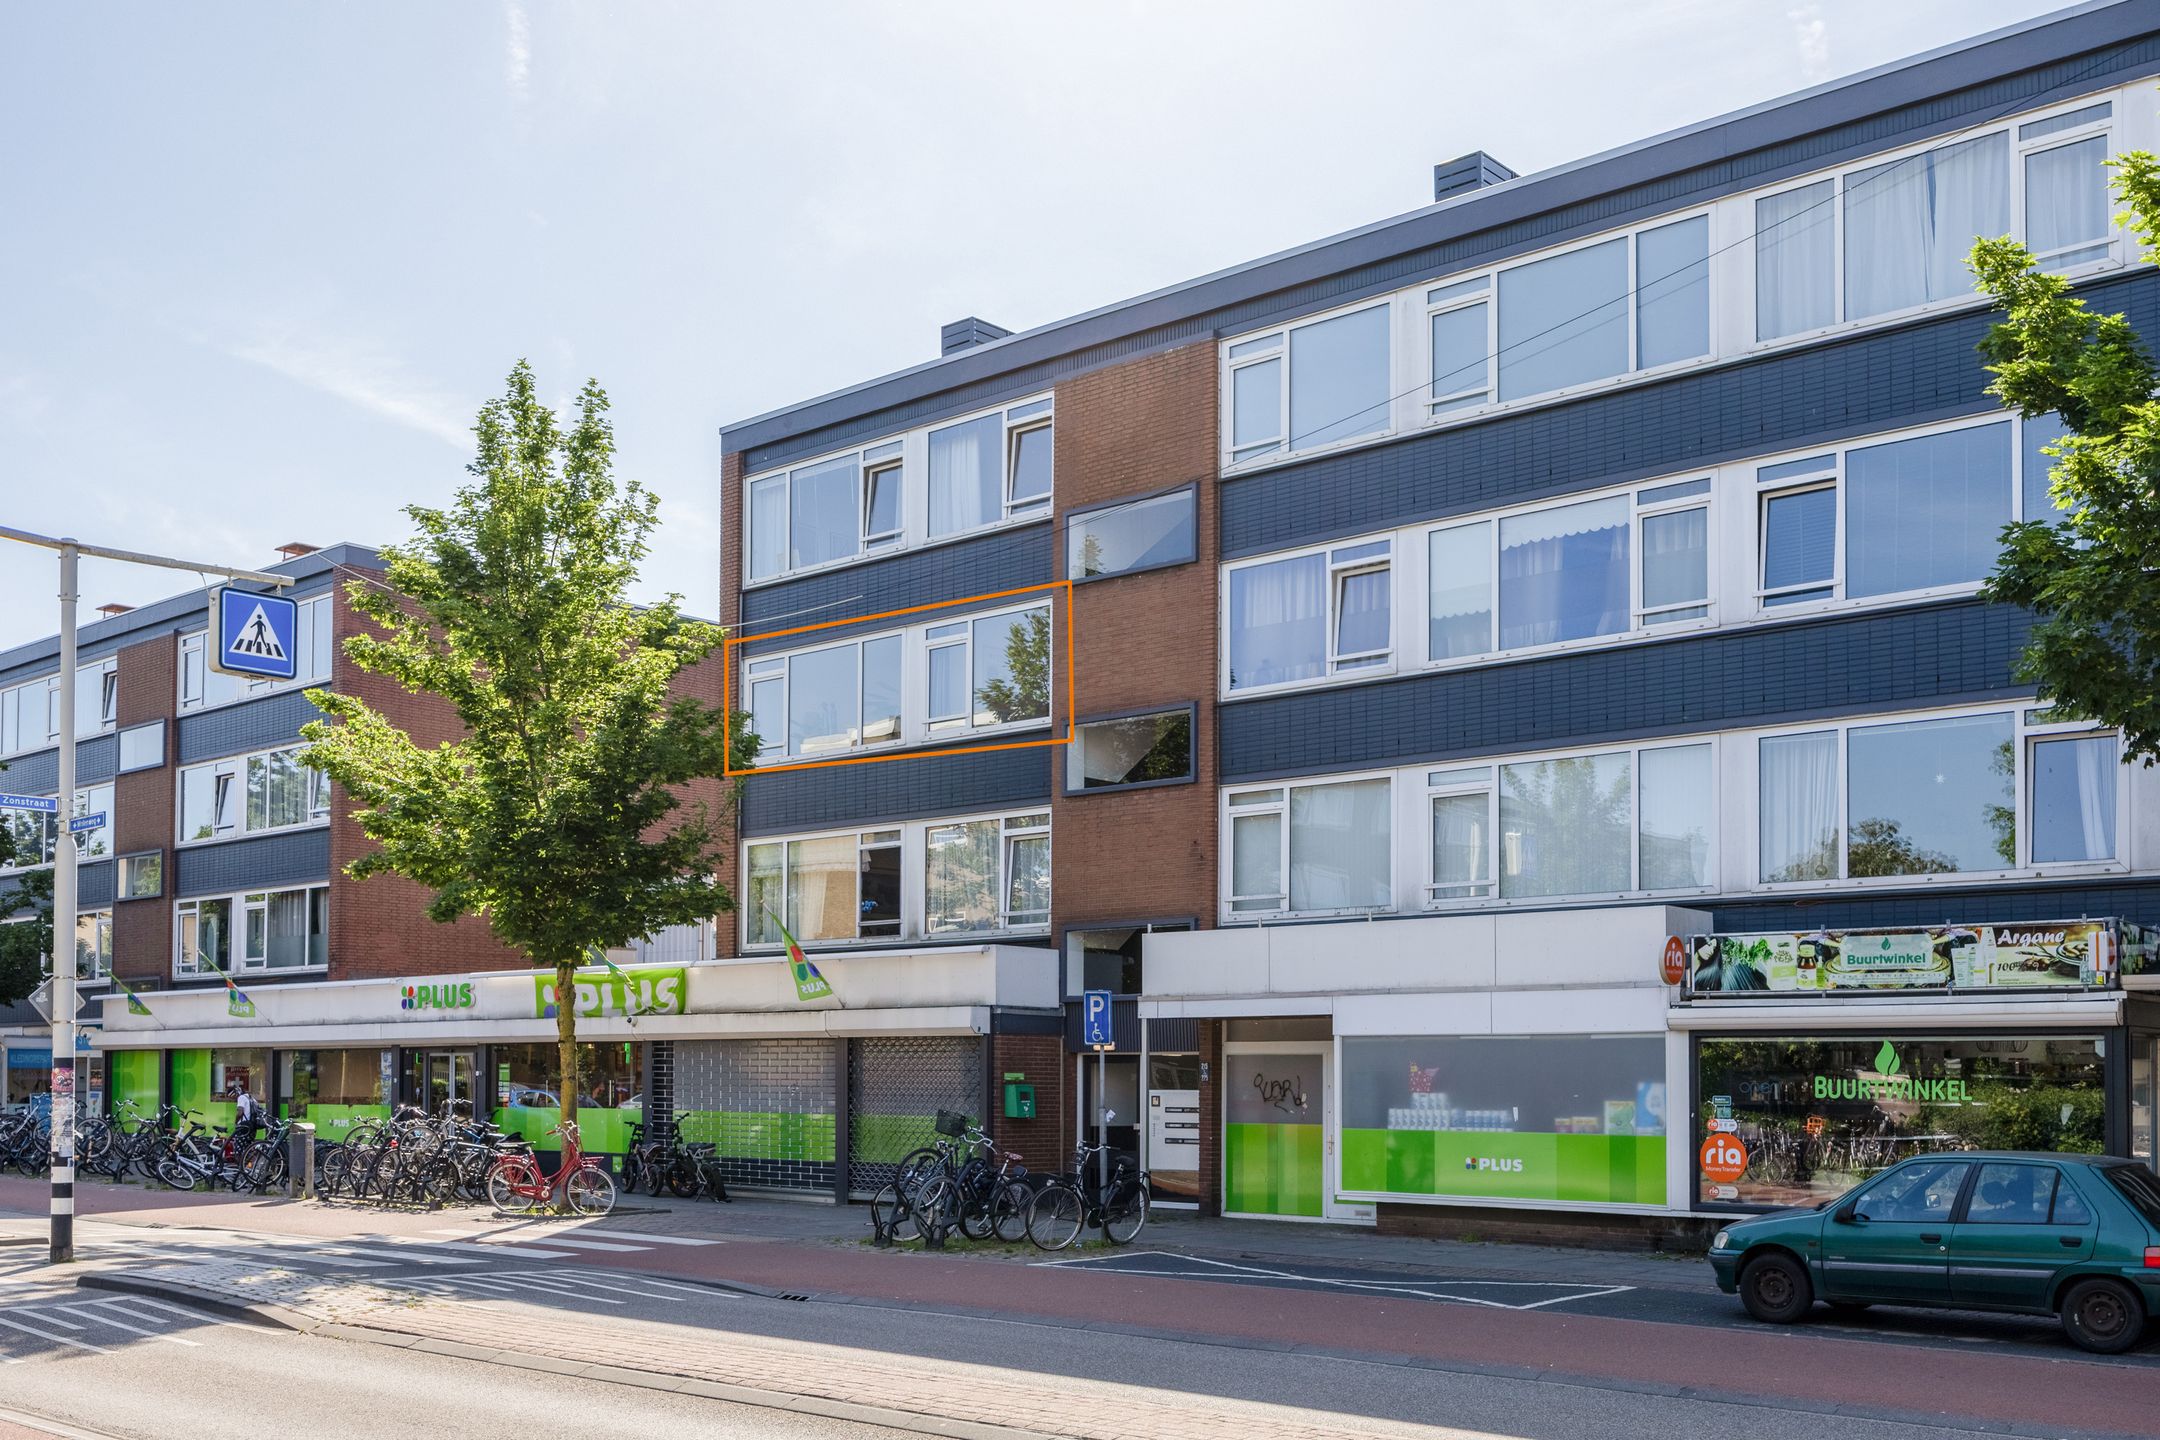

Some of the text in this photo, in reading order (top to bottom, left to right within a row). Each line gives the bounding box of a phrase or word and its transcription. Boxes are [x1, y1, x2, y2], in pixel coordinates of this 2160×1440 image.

[3, 796, 49, 808] Zonstraat
[1997, 929, 2064, 947] Argane
[1666, 943, 1683, 967] ria
[1847, 953, 1926, 965] Buurtwinkel
[417, 983, 473, 1009] PLUS
[573, 977, 679, 1017] PLUS
[1090, 995, 1105, 1022] P
[1814, 1075, 1973, 1101] BUURTWINKEL
[333, 1119, 350, 1128] PLUS
[1705, 1139, 1742, 1165] ria
[1479, 1158, 1523, 1172] PLUS
